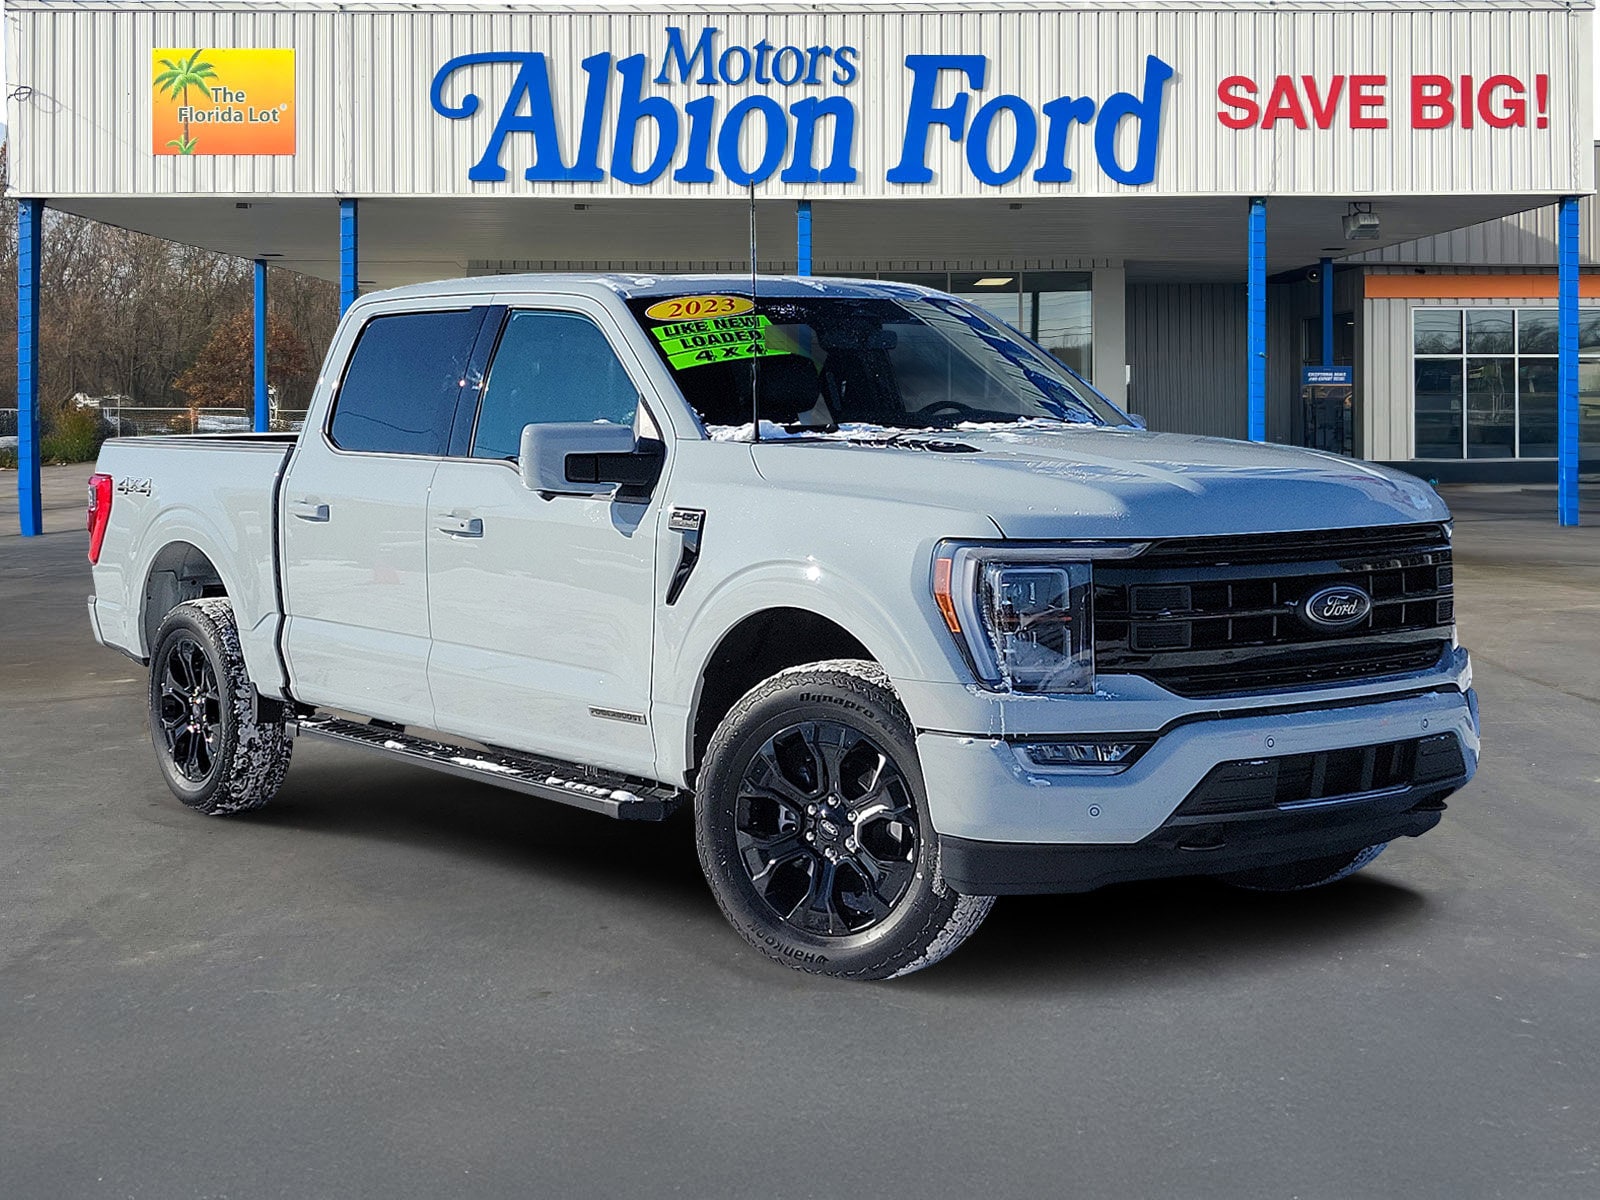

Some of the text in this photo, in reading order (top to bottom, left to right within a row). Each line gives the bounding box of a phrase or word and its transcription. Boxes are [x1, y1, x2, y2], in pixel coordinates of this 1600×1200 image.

[653, 27, 857, 86] Motors
[211, 87, 245, 103] The
[1217, 74, 1549, 129] SAVE BIG!
[178, 107, 243, 122] Florida
[430, 51, 1173, 186] Albion Ford
[668, 298, 736, 318] 2023
[662, 316, 761, 338] LIKE NEW
[680, 329, 763, 349] LOADED
[1323, 595, 1358, 617] Ford
